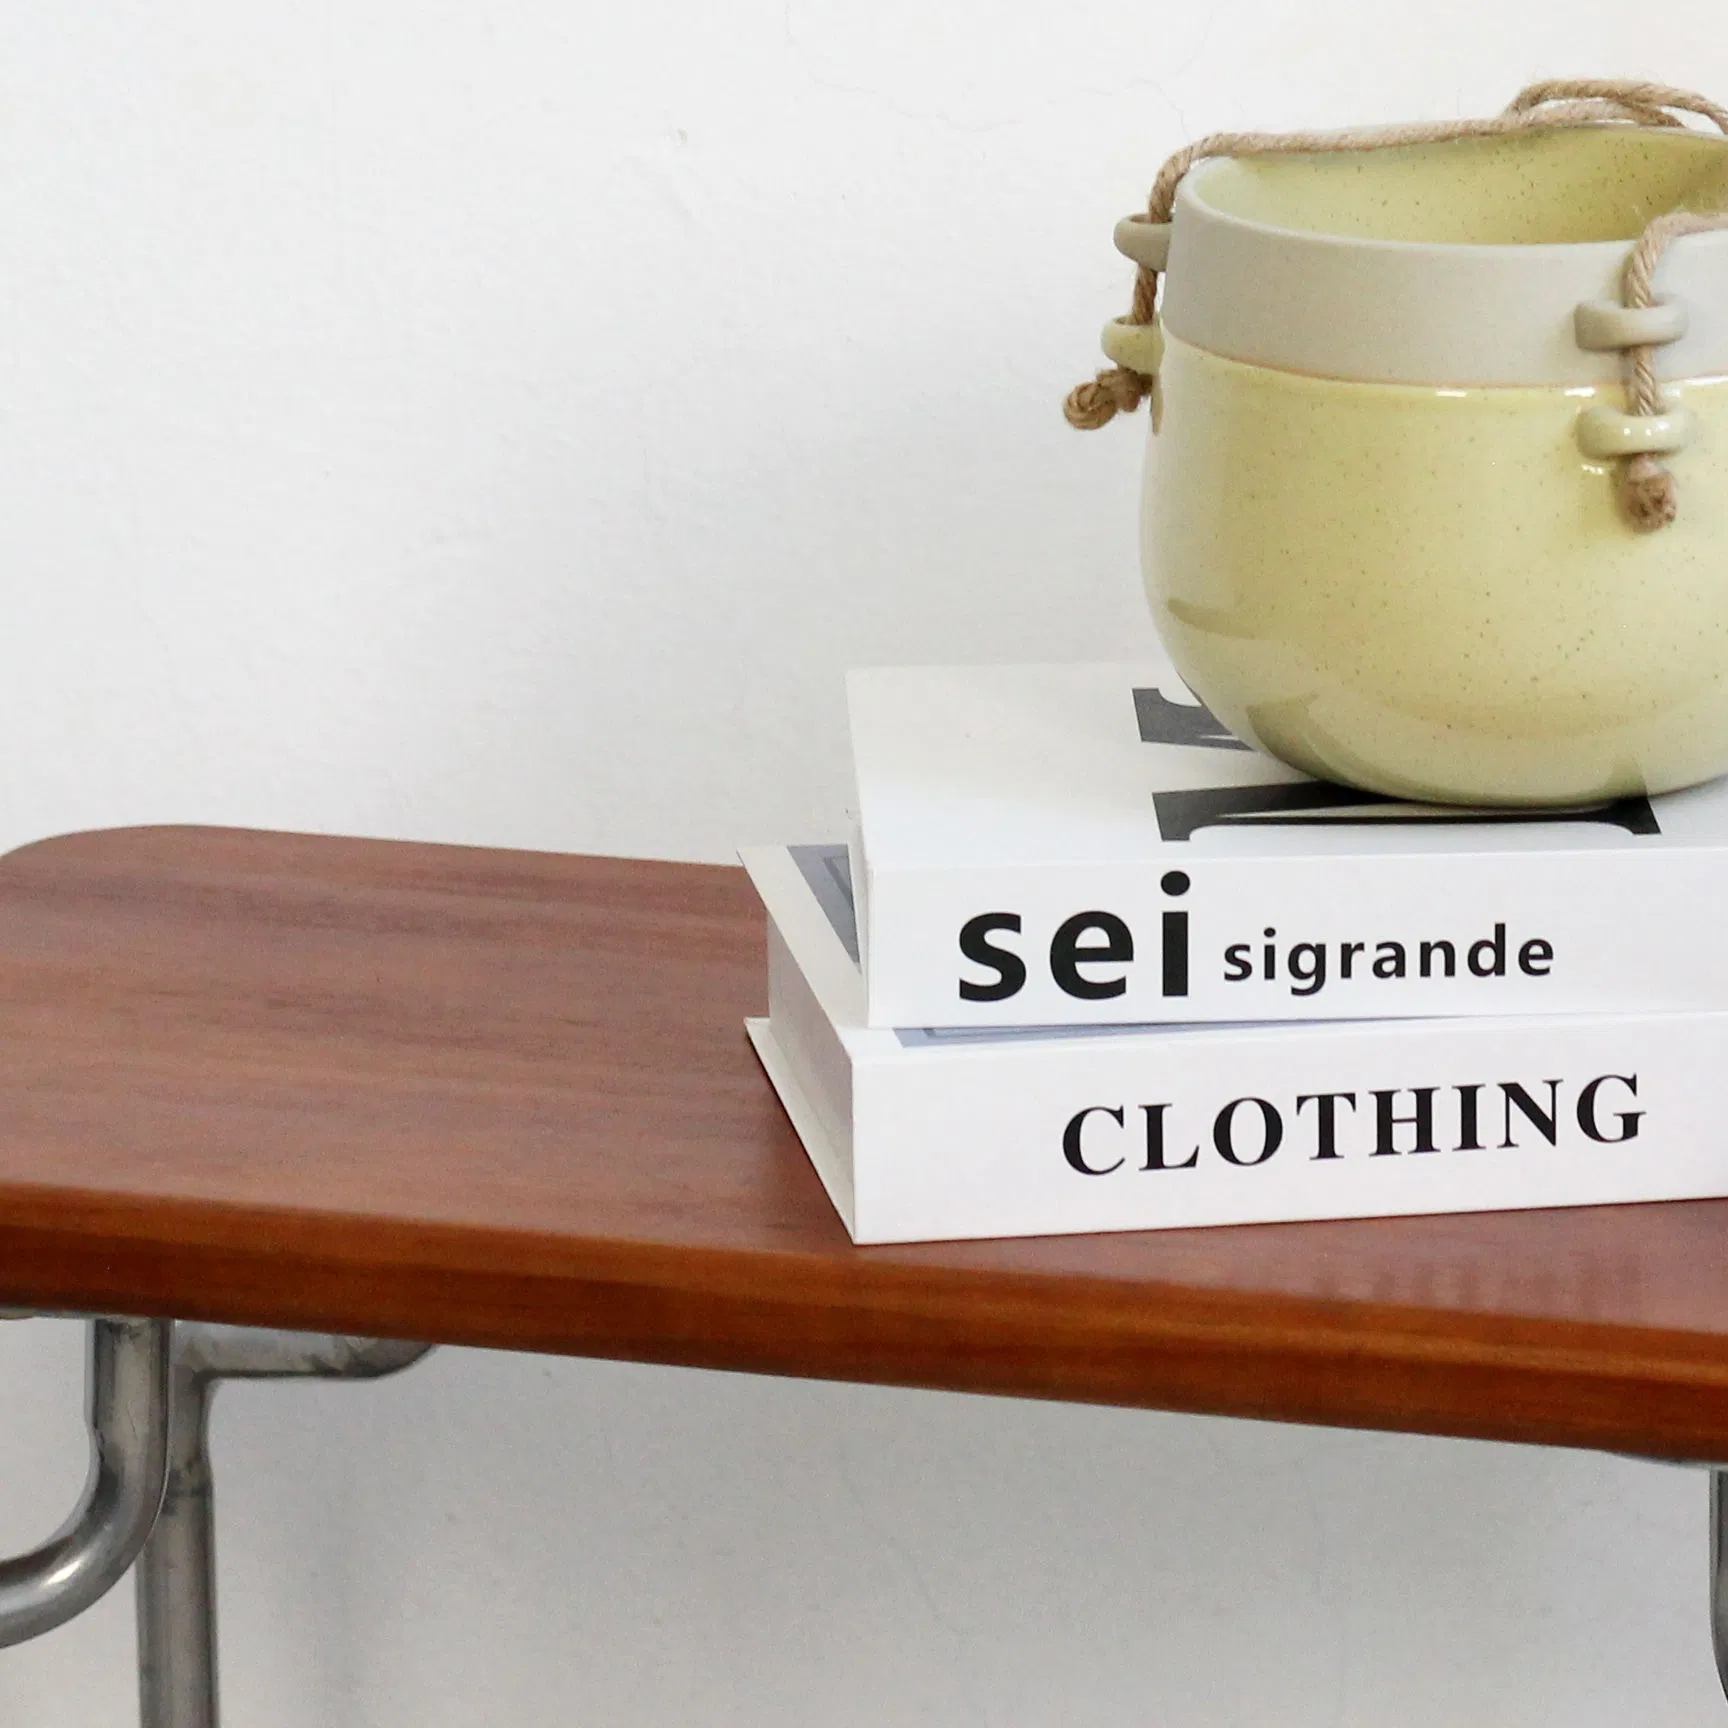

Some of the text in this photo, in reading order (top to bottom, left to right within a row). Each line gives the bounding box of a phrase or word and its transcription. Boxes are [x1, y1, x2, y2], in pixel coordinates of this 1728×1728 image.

[958, 870, 1555, 1002] sei sigrande
[1062, 1072, 1647, 1176] CLOTHING
